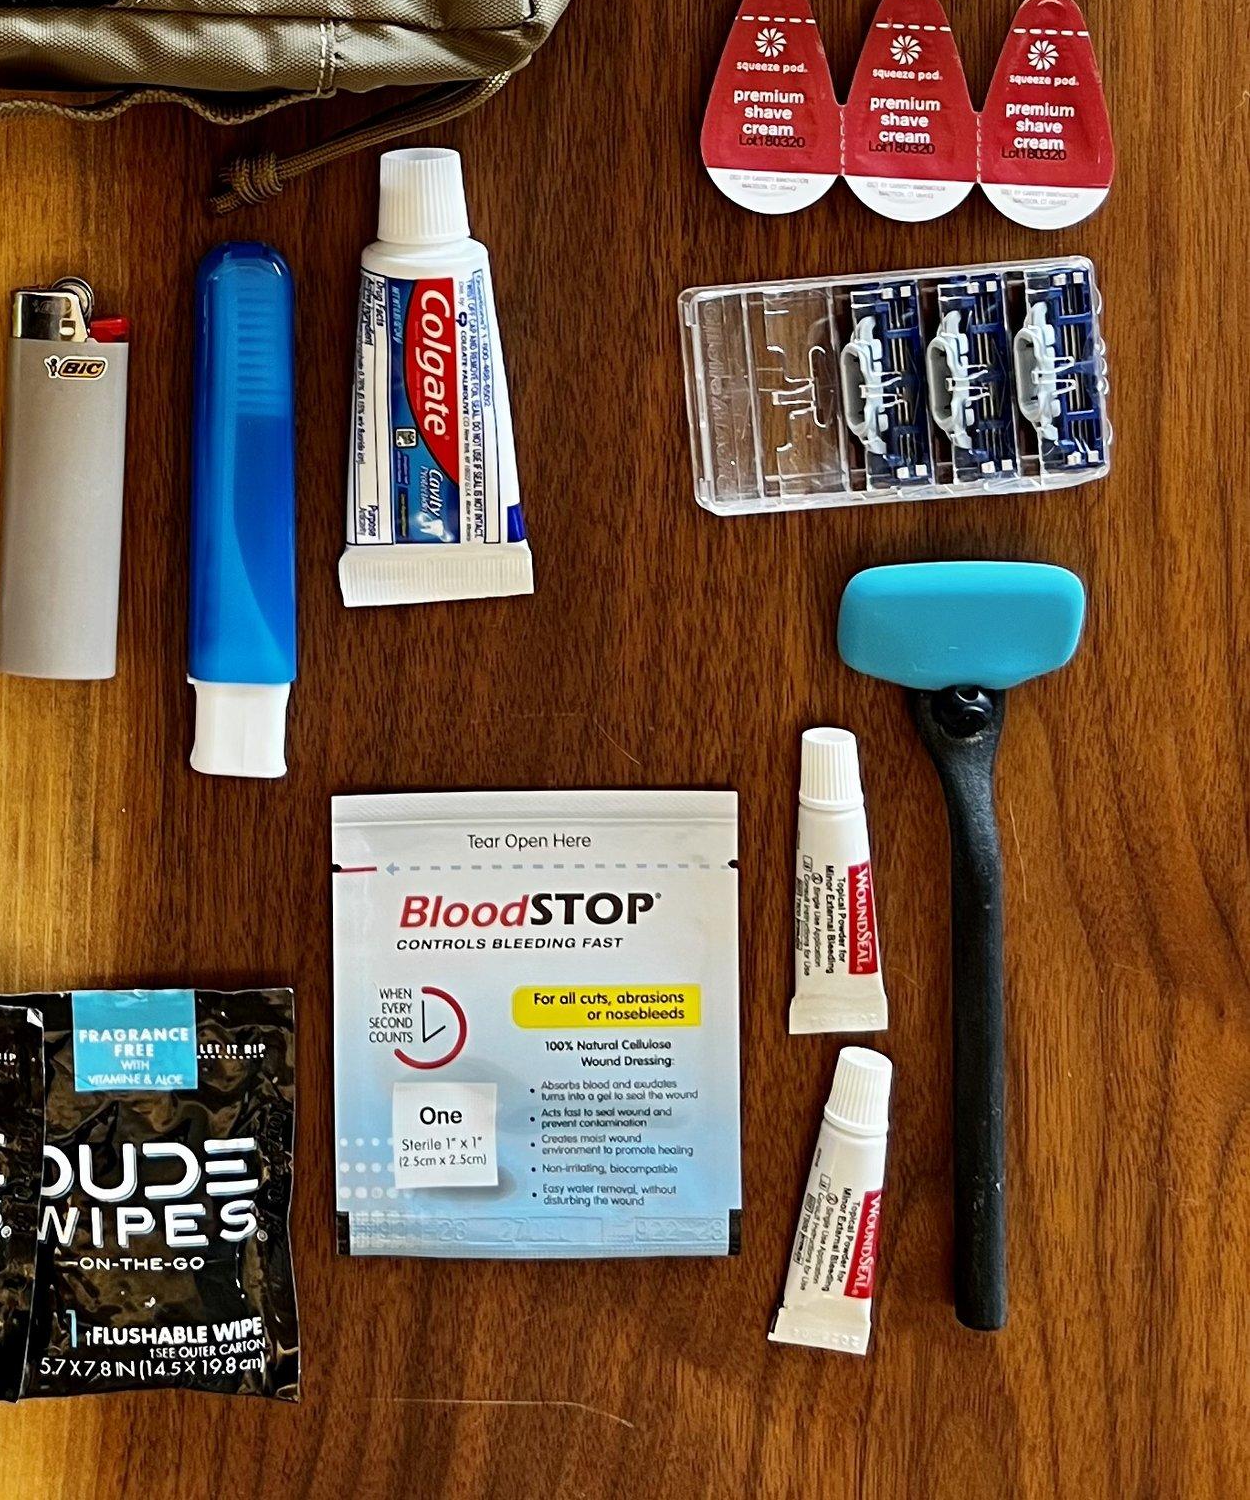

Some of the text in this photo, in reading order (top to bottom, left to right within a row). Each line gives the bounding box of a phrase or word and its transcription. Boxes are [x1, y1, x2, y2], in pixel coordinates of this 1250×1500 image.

[733, 89, 805, 106] premium
[870, 97, 941, 113] premium
[744, 105, 793, 121] shave
[1006, 102, 1075, 119] premium
[880, 112, 929, 129] shave
[1015, 118, 1063, 134] shave
[742, 123, 794, 137] cream
[878, 130, 931, 145] cream
[738, 134, 806, 149] Lot180320
[1013, 136, 1064, 150] cream
[61, 360, 106, 376] BIC
[414, 288, 453, 438] Colgate
[428, 468, 444, 518] Cavity
[467, 834, 592, 852] Tear Open Here
[399, 892, 655, 928] BloodSTOP
[396, 936, 624, 951] CONTROLS BLEEDING FAST
[379, 988, 412, 1000] WHEN
[533, 990, 685, 1006] For all cuts, abrasions
[381, 1002, 413, 1015] EVERY
[587, 1006, 685, 1021] or nosebleeds
[369, 1016, 413, 1029] SECOND
[79, 1027, 189, 1043] FRAGRANCE
[368, 1031, 414, 1044] COUNTS
[114, 1043, 155, 1058] FREE
[544, 1038, 672, 1052] 100% Natural Cellulose
[580, 1055, 676, 1068] Wound Dressing:
[419, 1106, 463, 1126] One
[541, 1107, 672, 1117] Acts fast to seal wound and
[541, 1118, 647, 1129] prevent contamination
[401, 1138, 442, 1151] Sterile
[460, 1139, 468, 1149] x
[541, 1134, 642, 1143] Creates moist wound
[439, 1156, 446, 1165] x
[449, 1153, 487, 1167] 2.5cm)
[80, 1256, 206, 1272] ON-THE-GO
